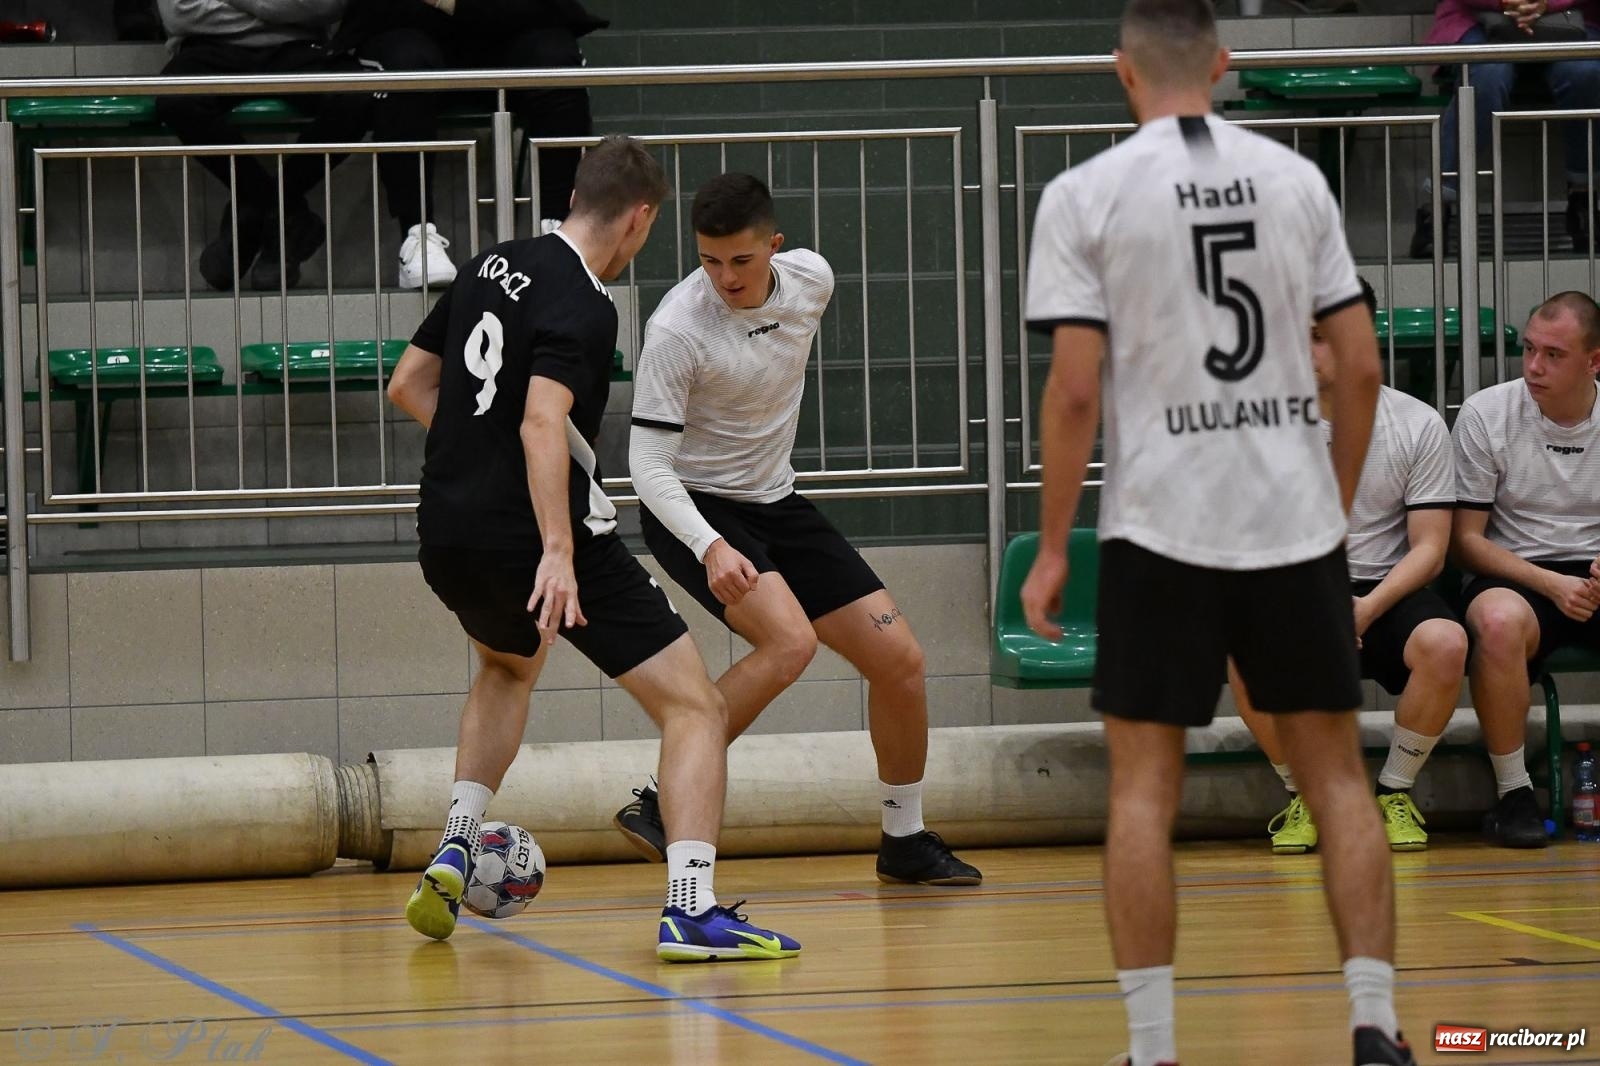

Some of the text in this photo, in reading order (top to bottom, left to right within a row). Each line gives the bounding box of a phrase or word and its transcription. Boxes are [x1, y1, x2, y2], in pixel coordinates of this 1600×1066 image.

[1175, 178, 1256, 208] Hadi
[1192, 221, 1264, 382] 5
[464, 311, 504, 416] 9
[1166, 397, 1318, 435] ULULANI FC
[515, 827, 530, 871] SELECT
